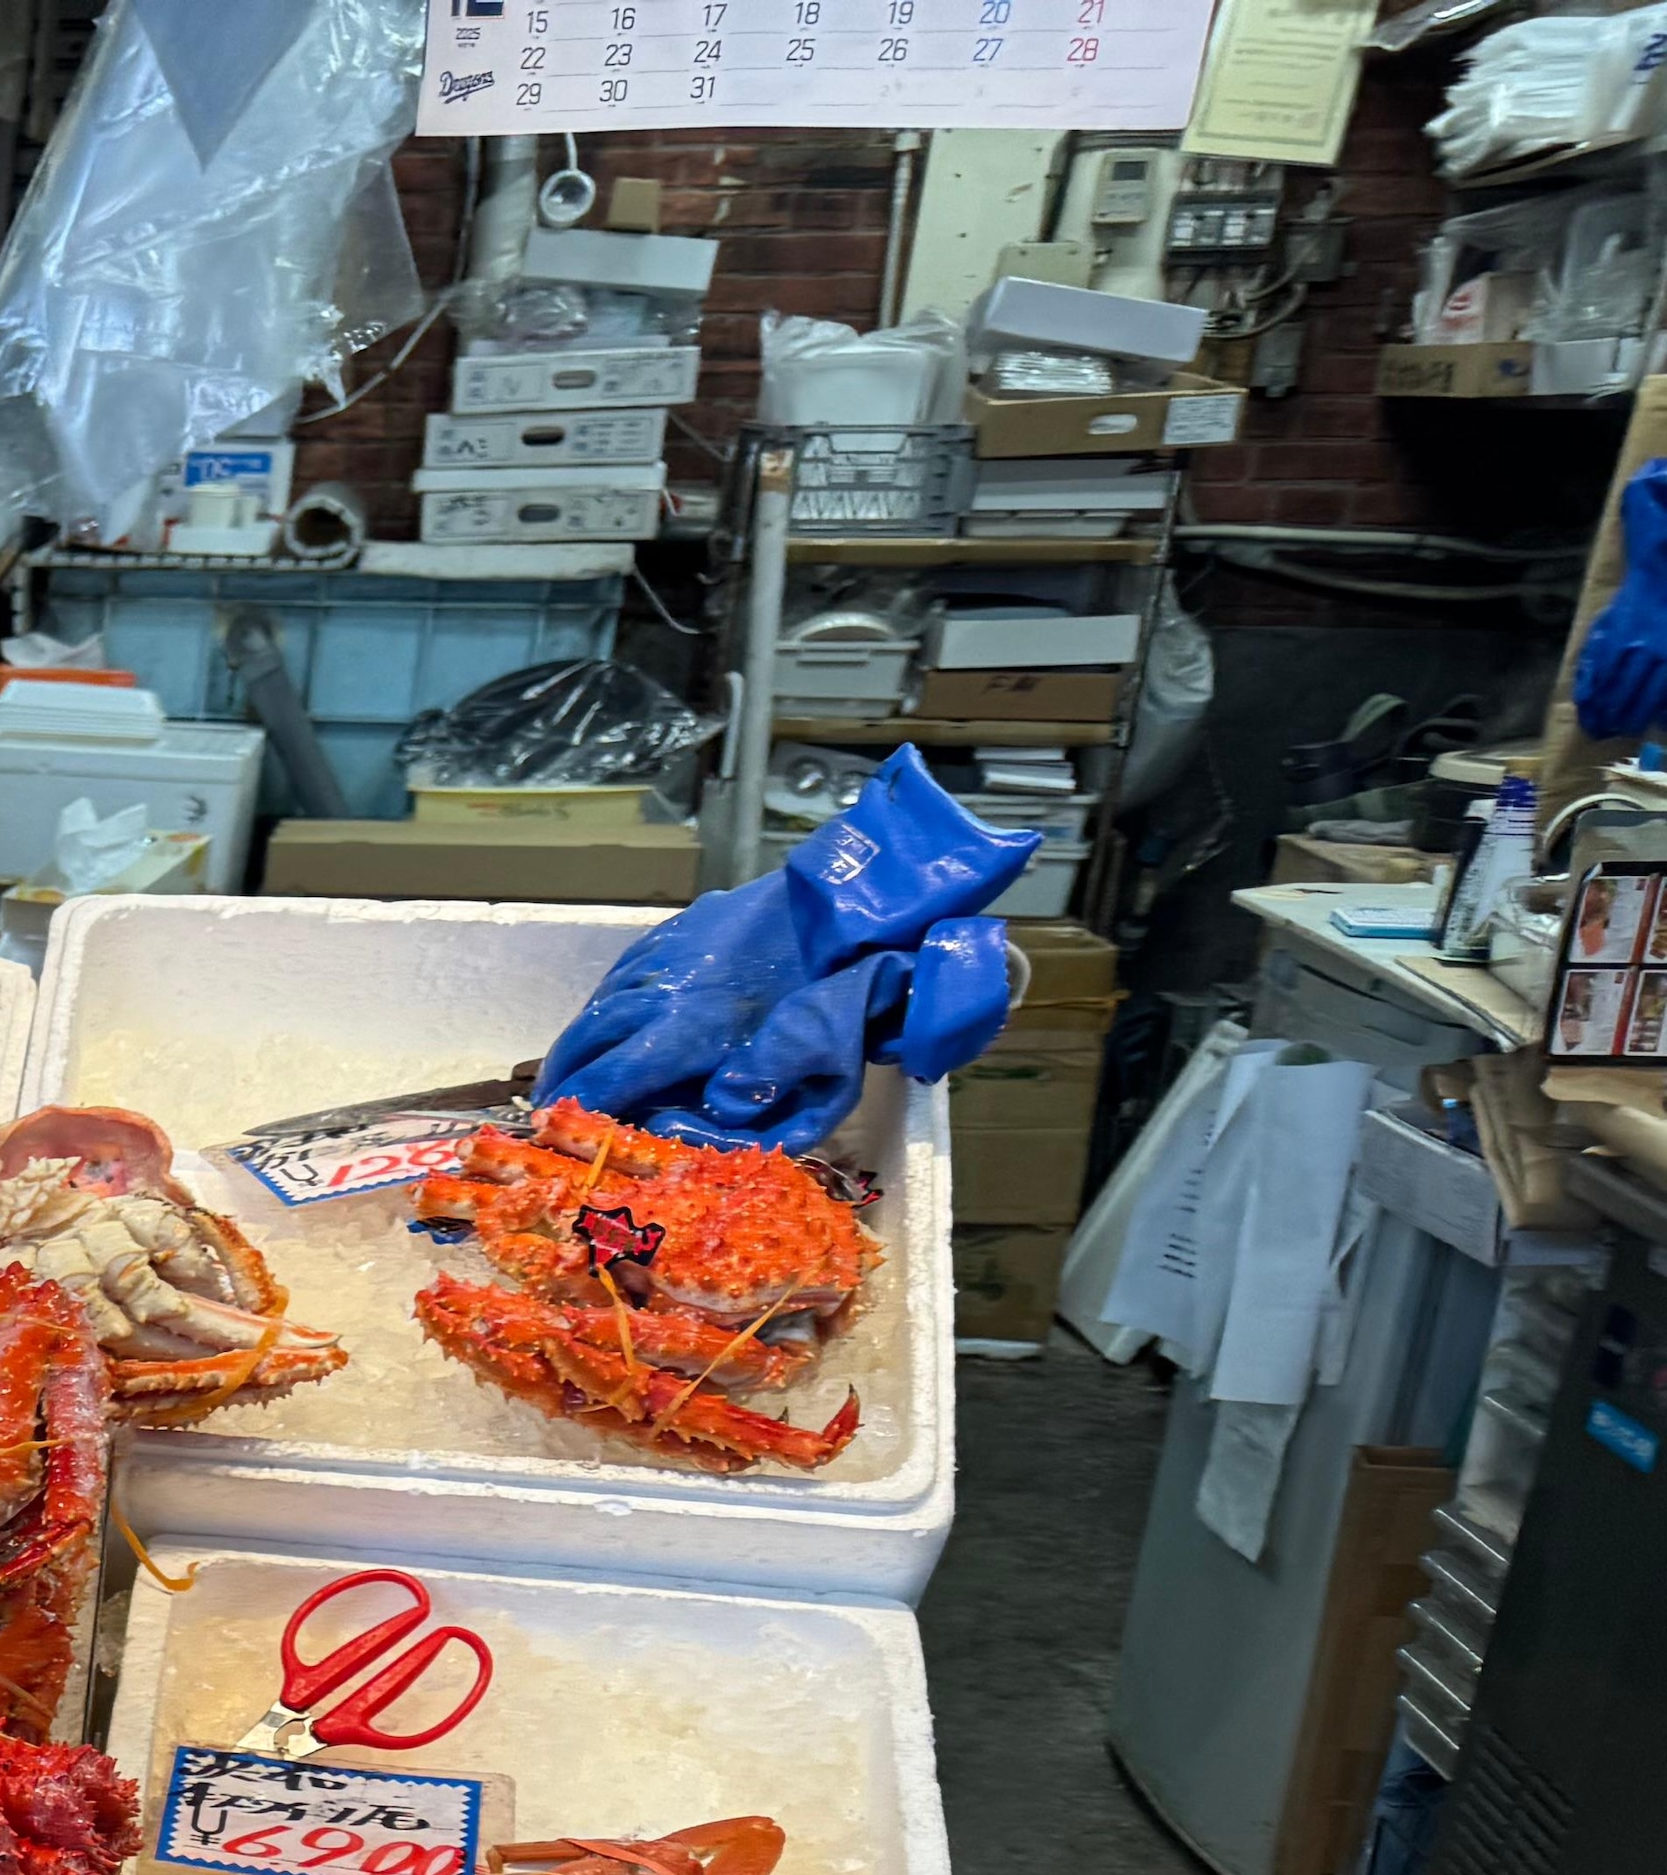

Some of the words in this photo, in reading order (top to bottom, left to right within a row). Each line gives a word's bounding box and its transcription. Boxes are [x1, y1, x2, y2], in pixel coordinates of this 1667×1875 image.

[527, 10, 549, 34] 15
[612, 7, 635, 31] 16
[702, 3, 727, 28] 17
[795, 1, 820, 25] 18
[889, 1, 914, 25] 19
[979, 0, 1011, 25] 20
[1077, 0, 1104, 25] 21
[520, 47, 545, 70] 22
[604, 44, 632, 67] 23
[694, 41, 721, 63] 24
[786, 39, 816, 62] 25
[877, 39, 908, 62] 26
[973, 38, 1004, 62] 27
[1067, 38, 1099, 62] 28
[516, 83, 542, 106] 29
[599, 80, 628, 102] 30
[690, 76, 716, 99] 31
